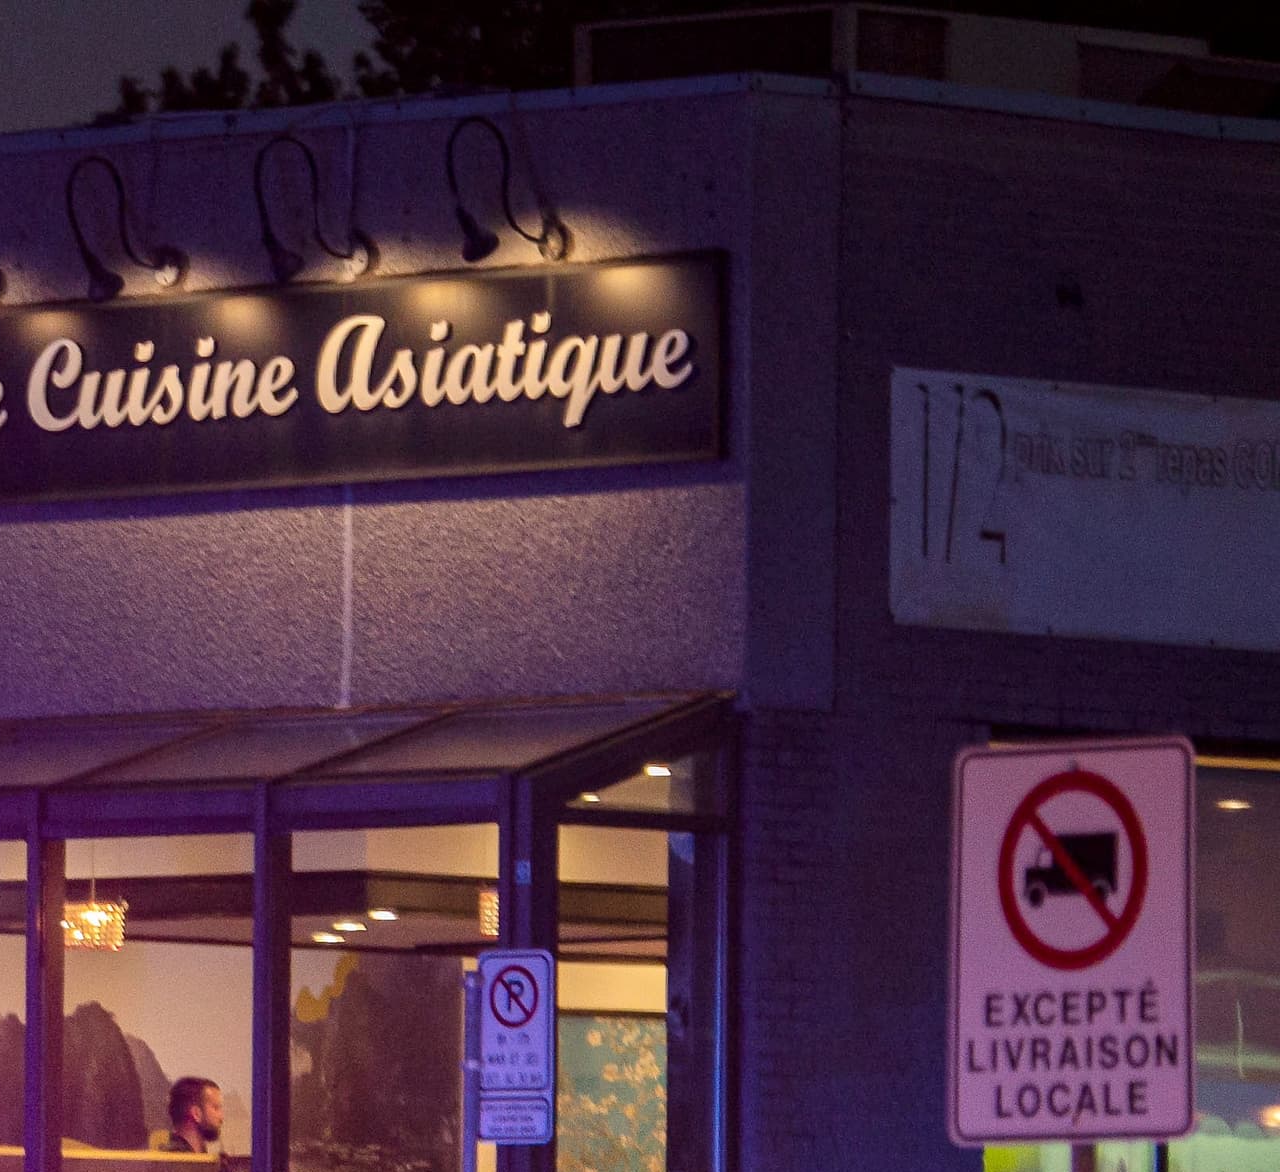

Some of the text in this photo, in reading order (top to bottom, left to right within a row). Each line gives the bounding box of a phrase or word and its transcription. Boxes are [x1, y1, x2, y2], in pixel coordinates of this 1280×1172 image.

[27, 335, 299, 433] Cuisine
[317, 310, 694, 429] Asiatique
[984, 978, 1161, 1029] EXCEPTÉ
[966, 1033, 1179, 1074] LIVRAISON
[995, 1079, 1150, 1121] LOCALE
